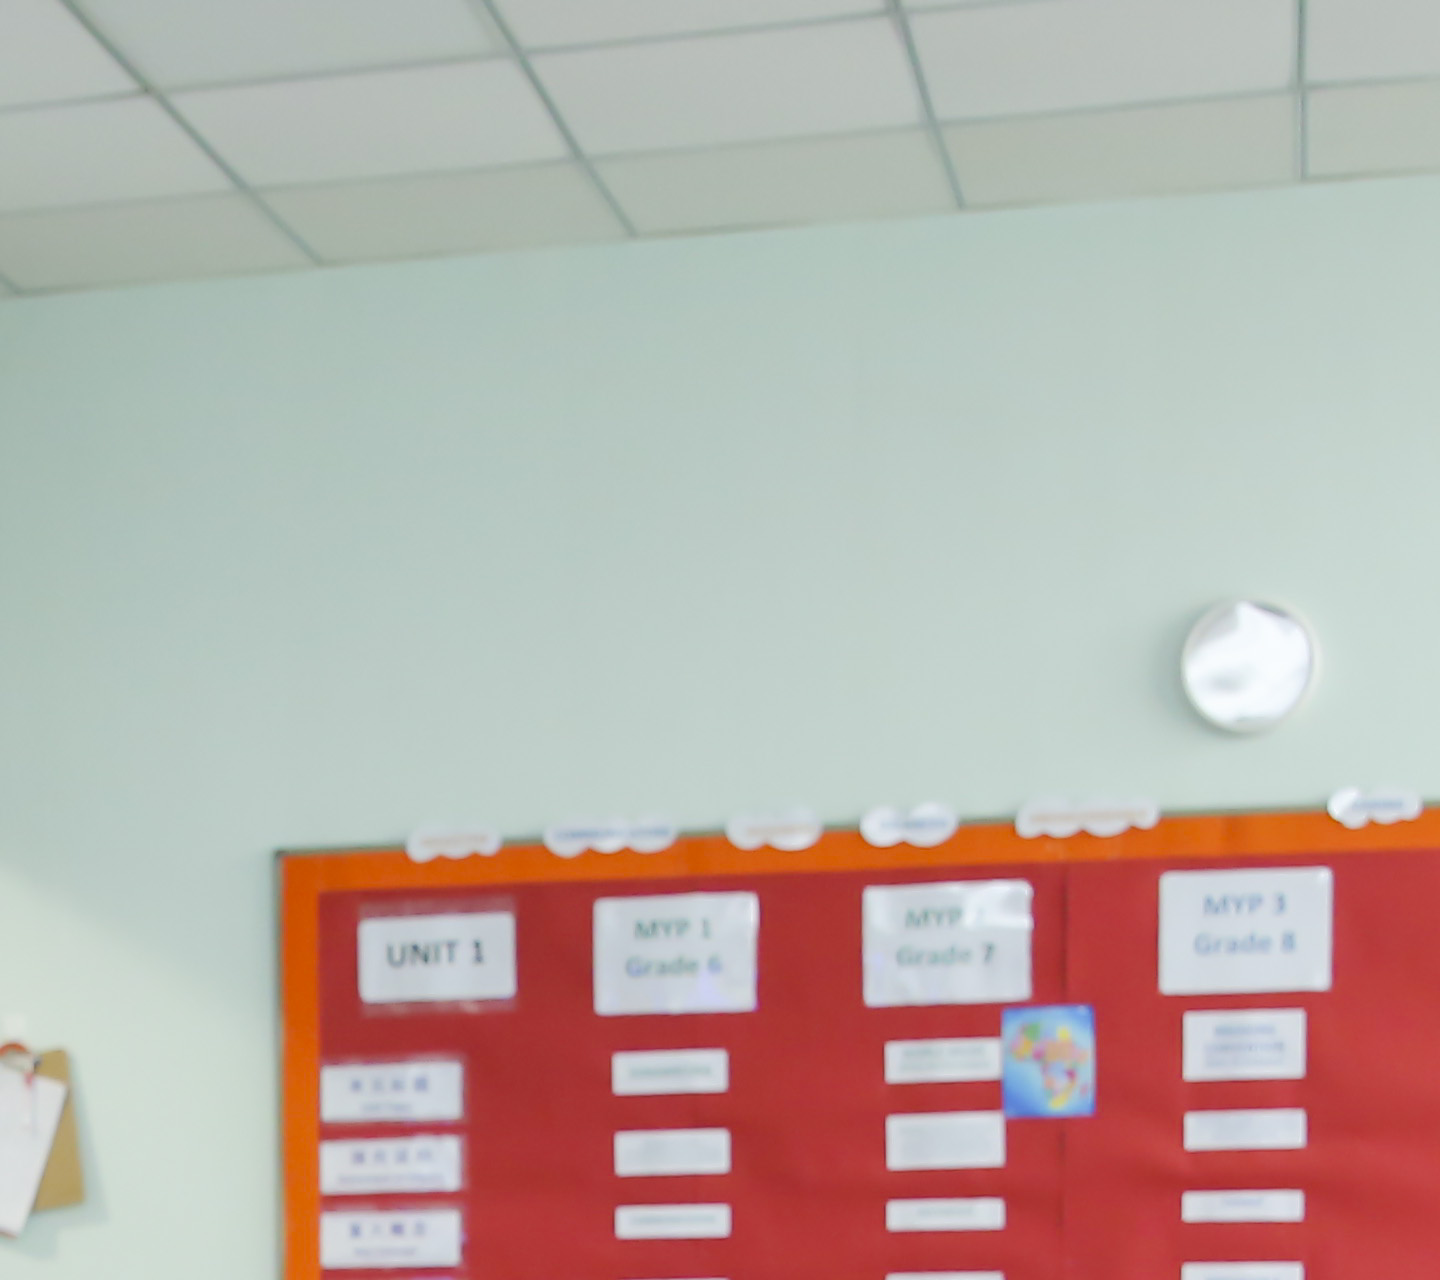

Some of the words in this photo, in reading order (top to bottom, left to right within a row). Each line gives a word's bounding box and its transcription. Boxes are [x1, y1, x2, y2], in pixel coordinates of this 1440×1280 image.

[1204, 896, 1264, 916] MYP
[1274, 895, 1286, 915] 3
[635, 920, 691, 940] MYP
[701, 919, 712, 939] 1
[905, 908, 964, 929] MYP
[386, 940, 459, 967] UNIT
[472, 941, 484, 964] 1
[896, 945, 971, 967] Grade
[984, 944, 995, 963] 7
[1194, 934, 1272, 957] Grade
[1282, 933, 1296, 953] 8
[625, 955, 699, 977] Grade
[707, 956, 723, 974] 6
